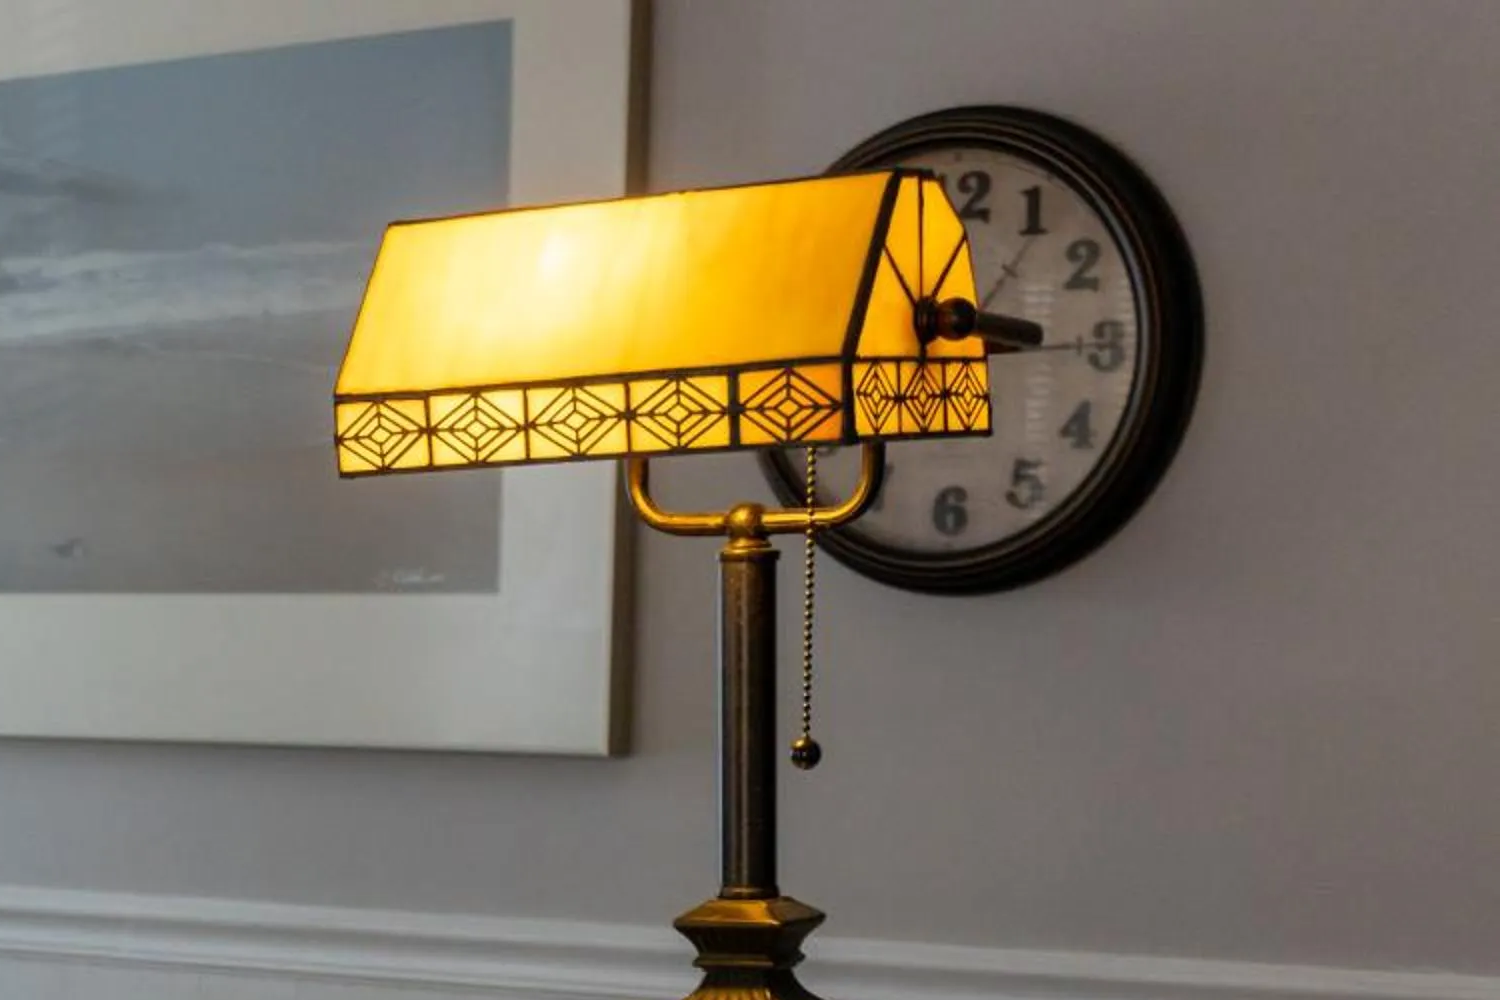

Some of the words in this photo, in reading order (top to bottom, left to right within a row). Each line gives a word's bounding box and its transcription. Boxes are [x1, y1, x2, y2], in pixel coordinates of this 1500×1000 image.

[939, 170, 991, 224] 2
[1019, 186, 1048, 236] 1
[1064, 239, 1101, 291] 2
[1088, 320, 1126, 373] 3
[1060, 402, 1095, 450] 4
[1005, 459, 1045, 510] 5
[933, 486, 968, 536] 6
